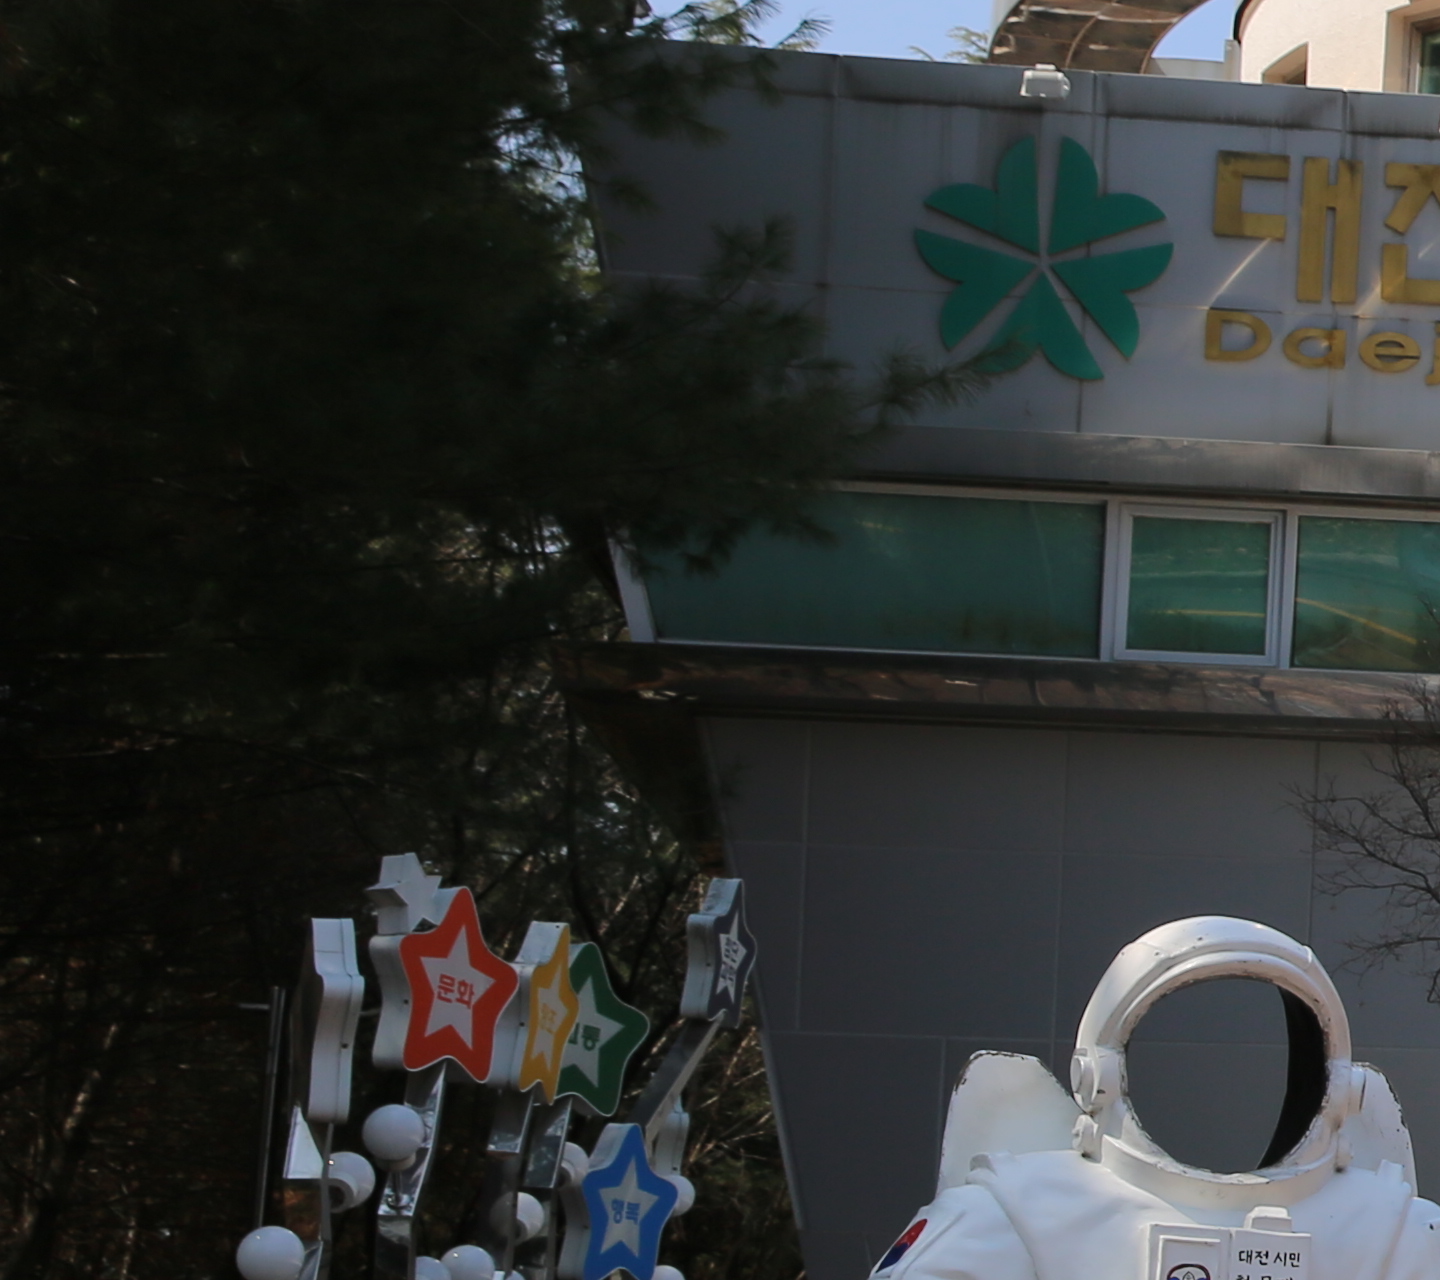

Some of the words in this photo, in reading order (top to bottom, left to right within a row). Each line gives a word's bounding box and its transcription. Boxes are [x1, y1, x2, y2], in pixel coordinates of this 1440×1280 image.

[437, 972, 475, 1010] 문화
[1238, 1249, 1270, 1267] 대전
[1273, 1251, 1301, 1269] 시민
